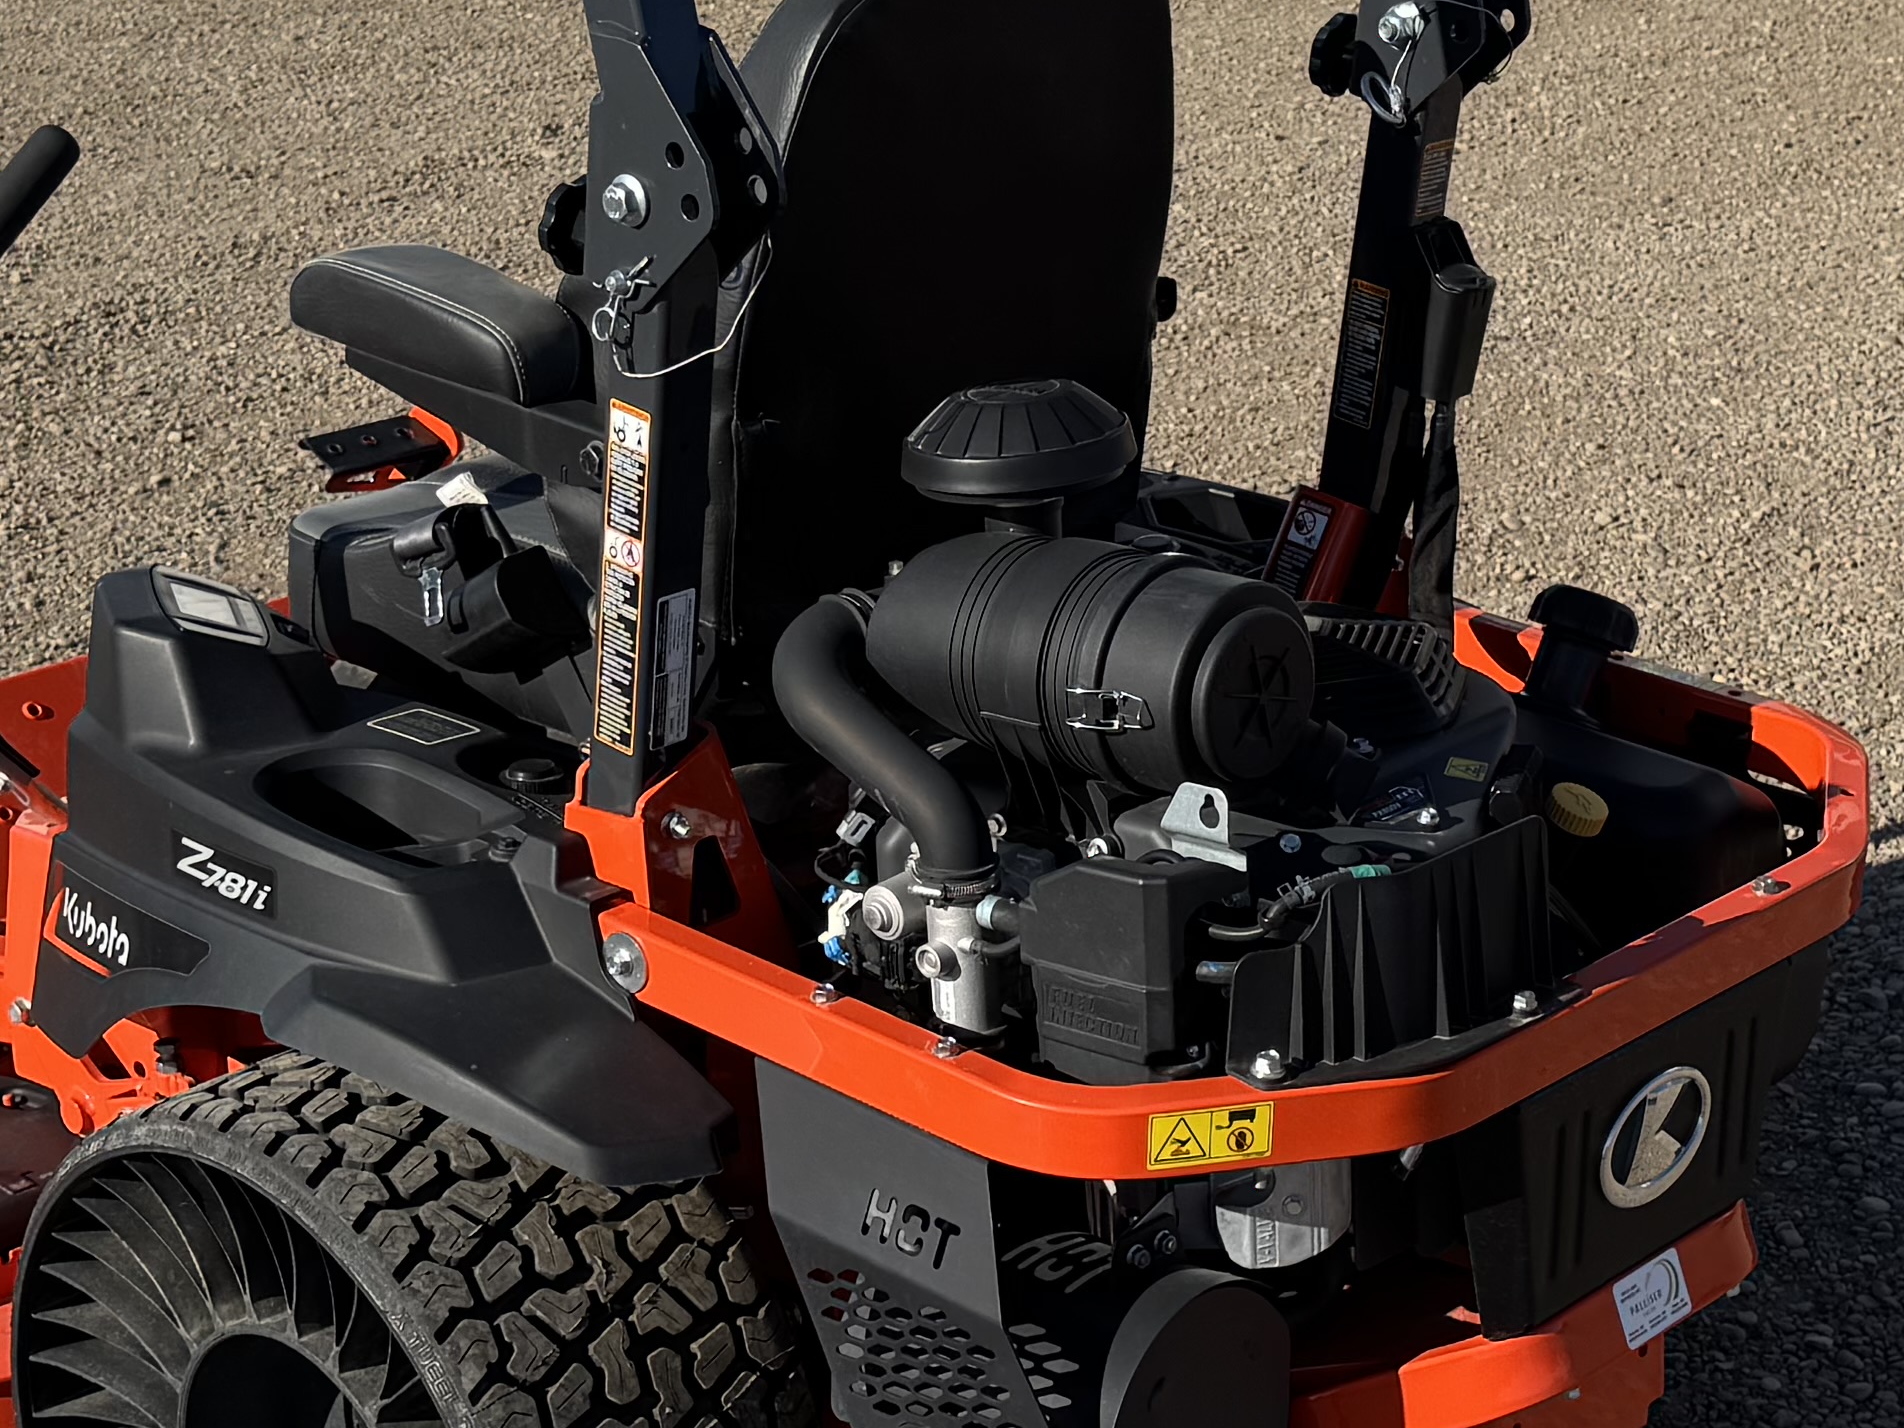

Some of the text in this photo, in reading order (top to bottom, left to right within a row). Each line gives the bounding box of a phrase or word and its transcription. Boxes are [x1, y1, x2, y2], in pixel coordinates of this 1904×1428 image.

[176, 836, 272, 911] Z781i
[62, 886, 130, 967] Kubota
[1047, 985, 1096, 1013] FUEL
[860, 1187, 962, 1271] HOT
